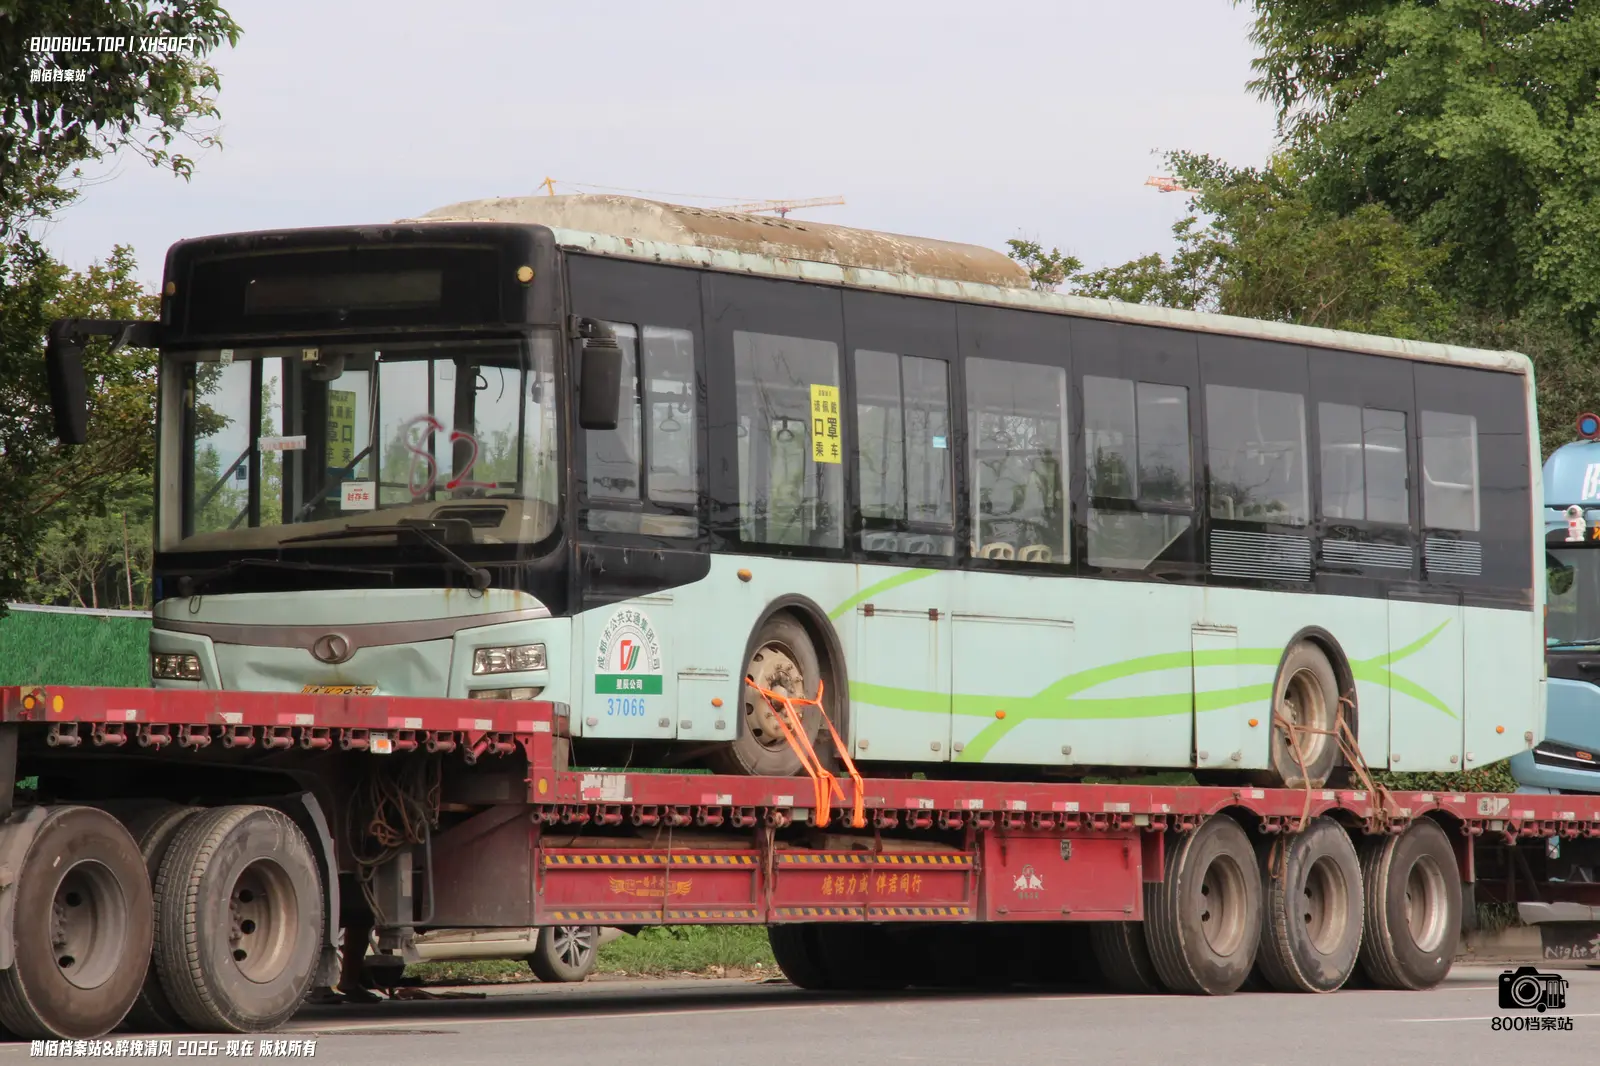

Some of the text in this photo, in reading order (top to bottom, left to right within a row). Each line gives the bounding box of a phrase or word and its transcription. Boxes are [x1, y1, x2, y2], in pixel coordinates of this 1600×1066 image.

[814, 416, 838, 439] 口罩
[815, 441, 839, 459] 乘车
[597, 609, 661, 670] 成都市公共交通集团公司
[607, 698, 646, 717] 37066
